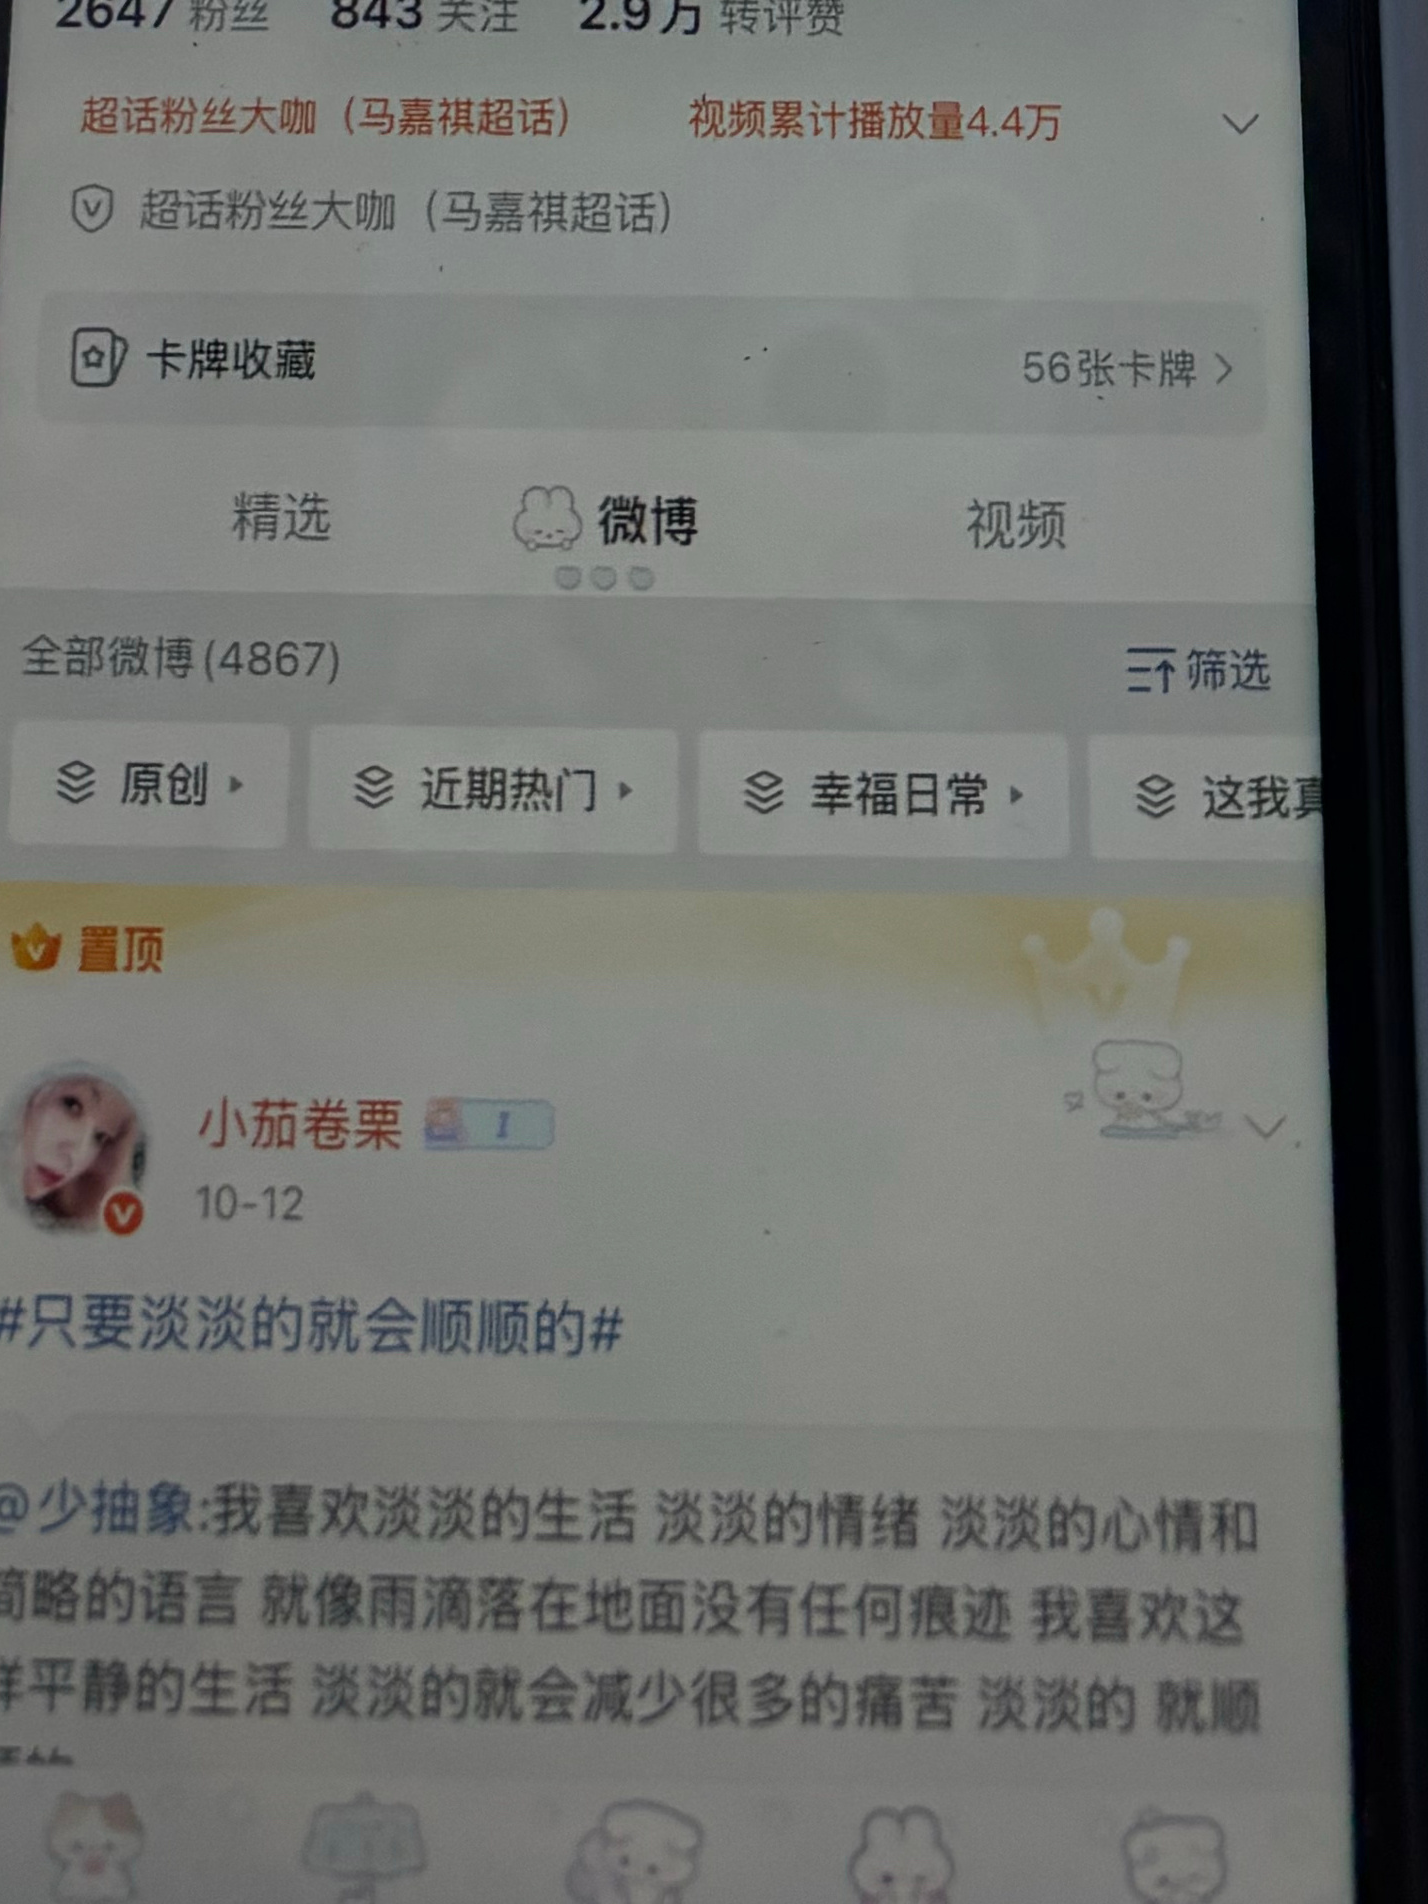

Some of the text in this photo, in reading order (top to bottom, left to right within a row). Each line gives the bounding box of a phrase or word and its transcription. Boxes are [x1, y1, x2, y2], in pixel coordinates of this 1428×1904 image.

[688, 99, 1062, 142] 视频累计播放量4.4万
[146, 337, 316, 381] 卡牌收藏
[1023, 348, 1197, 389] 56张卡牌
[232, 491, 332, 542] 精选
[598, 494, 699, 547] 微博
[966, 497, 1067, 550] 视频
[1186, 647, 1272, 692] 筛选
[120, 761, 209, 807] 原创
[421, 766, 596, 813] 近期热门
[811, 770, 988, 818] 幸福日常
[77, 925, 165, 974] 置顶
[198, 1095, 403, 1151] 小茄卷栗
[195, 1183, 304, 1223] 10-12
[656, 1489, 919, 1550] 淡淡的情绪
[940, 1493, 1259, 1555] 淡淡的心情和
[261, 1573, 1012, 1644] 就像雨滴落在地面没有任何痕迹
[1030, 1585, 1244, 1647] 我喜欢这
[311, 1663, 958, 1731] 淡淡的就会减少很多的痛苦
[978, 1675, 1137, 1735] 淡淡的
[1156, 1678, 1261, 1737] 就顺
